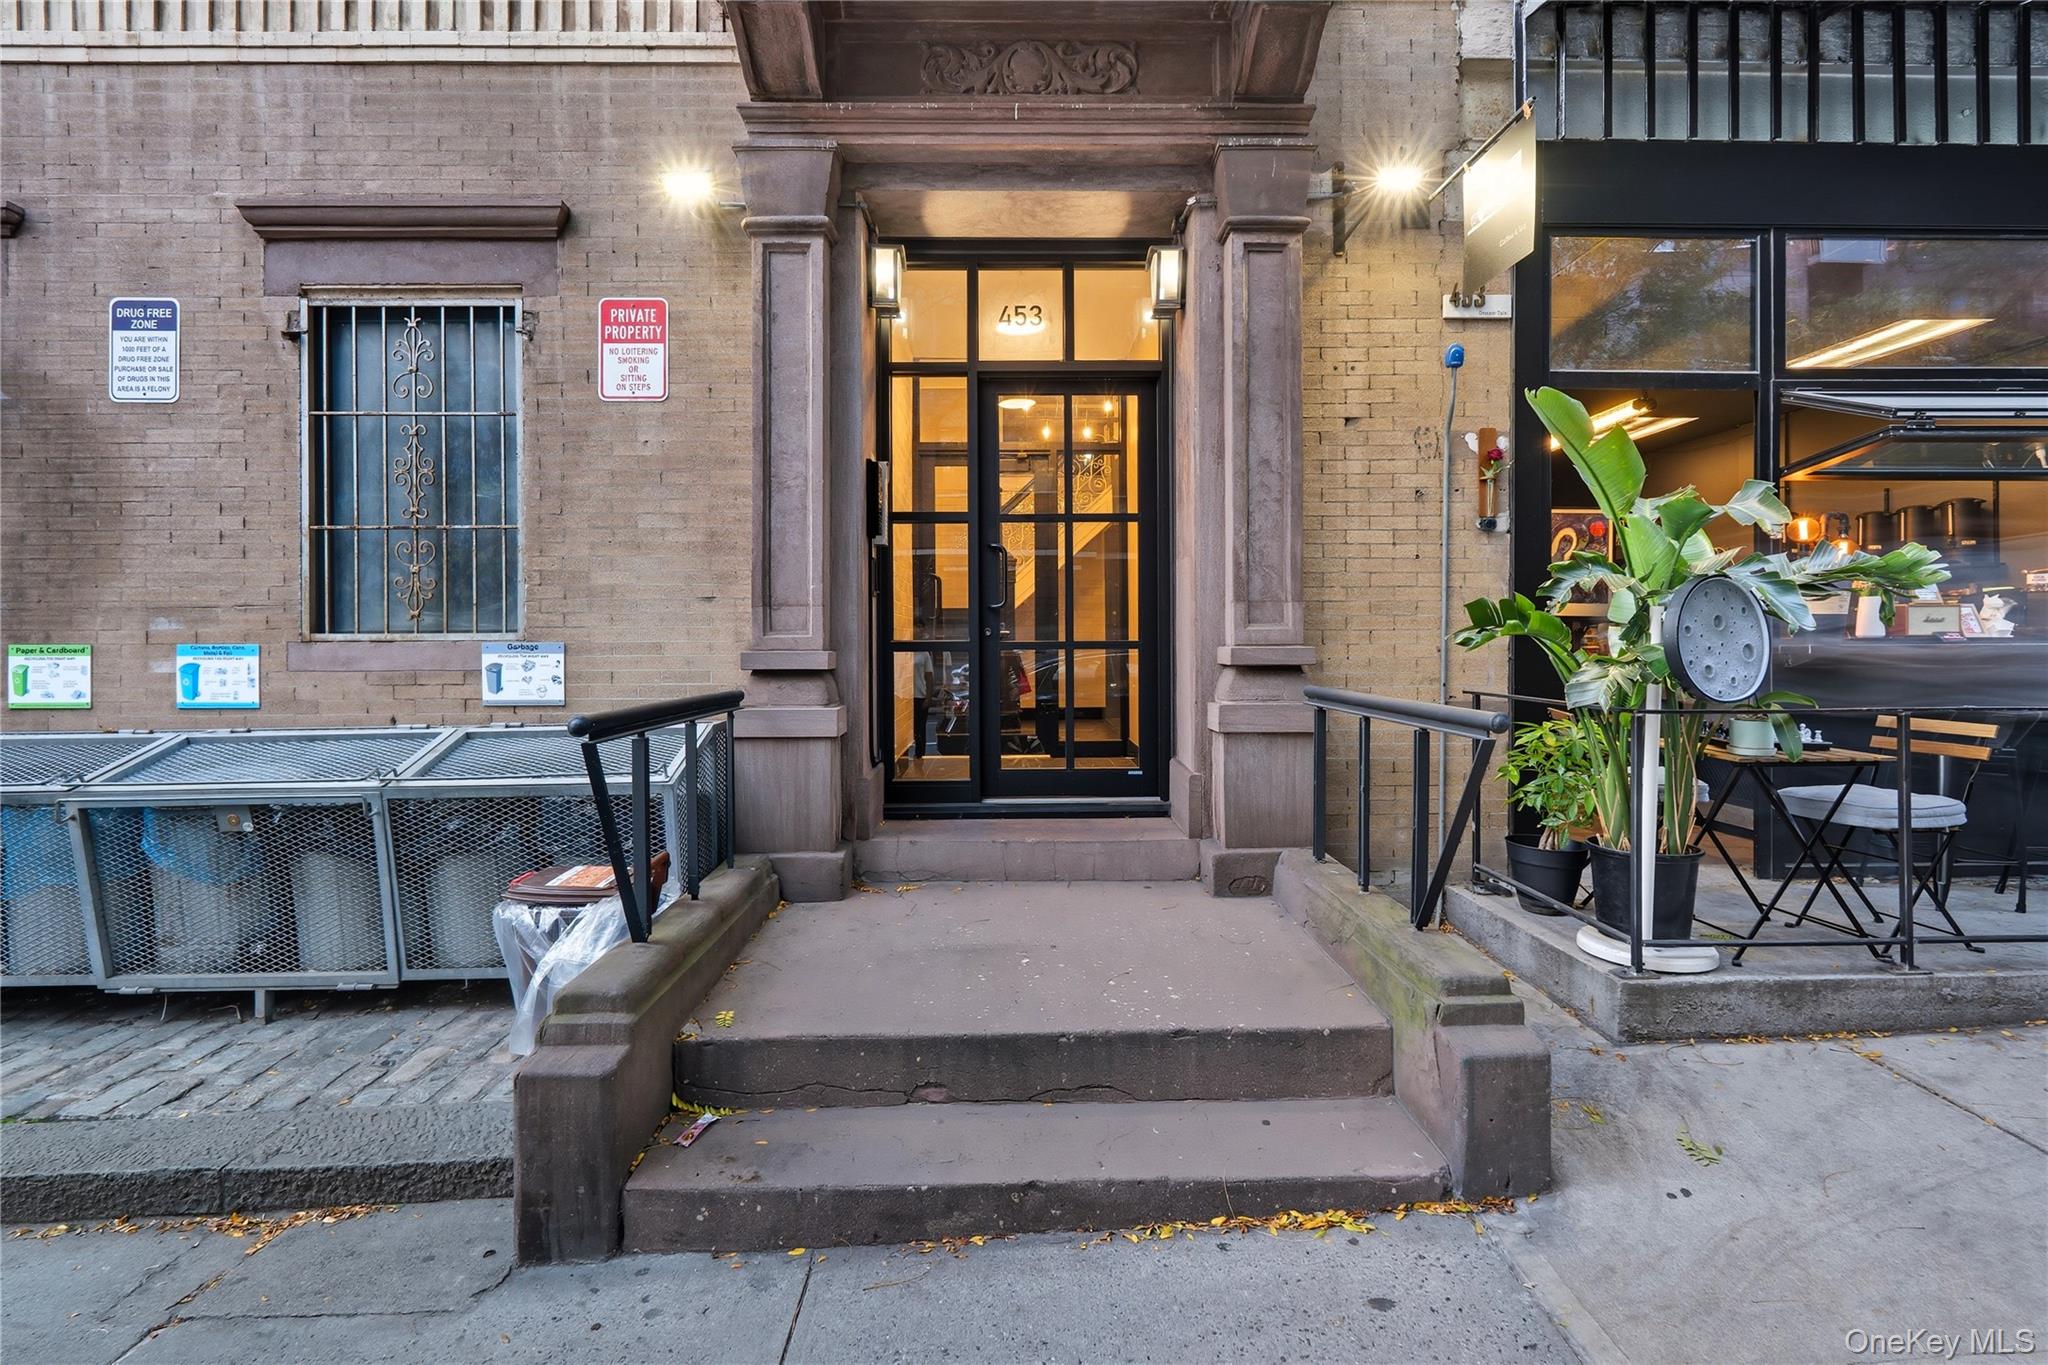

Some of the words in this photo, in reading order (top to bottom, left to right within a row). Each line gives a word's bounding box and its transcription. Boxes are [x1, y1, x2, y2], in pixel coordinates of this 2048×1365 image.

[116, 308, 144, 318] DRUG
[147, 308, 172, 318] FREE
[610, 309, 656, 323] PRIVATE
[999, 305, 1042, 326] 453
[130, 319, 157, 329] ZONE
[604, 325, 662, 339] PROPERTY
[507, 643, 539, 651] Garbage
